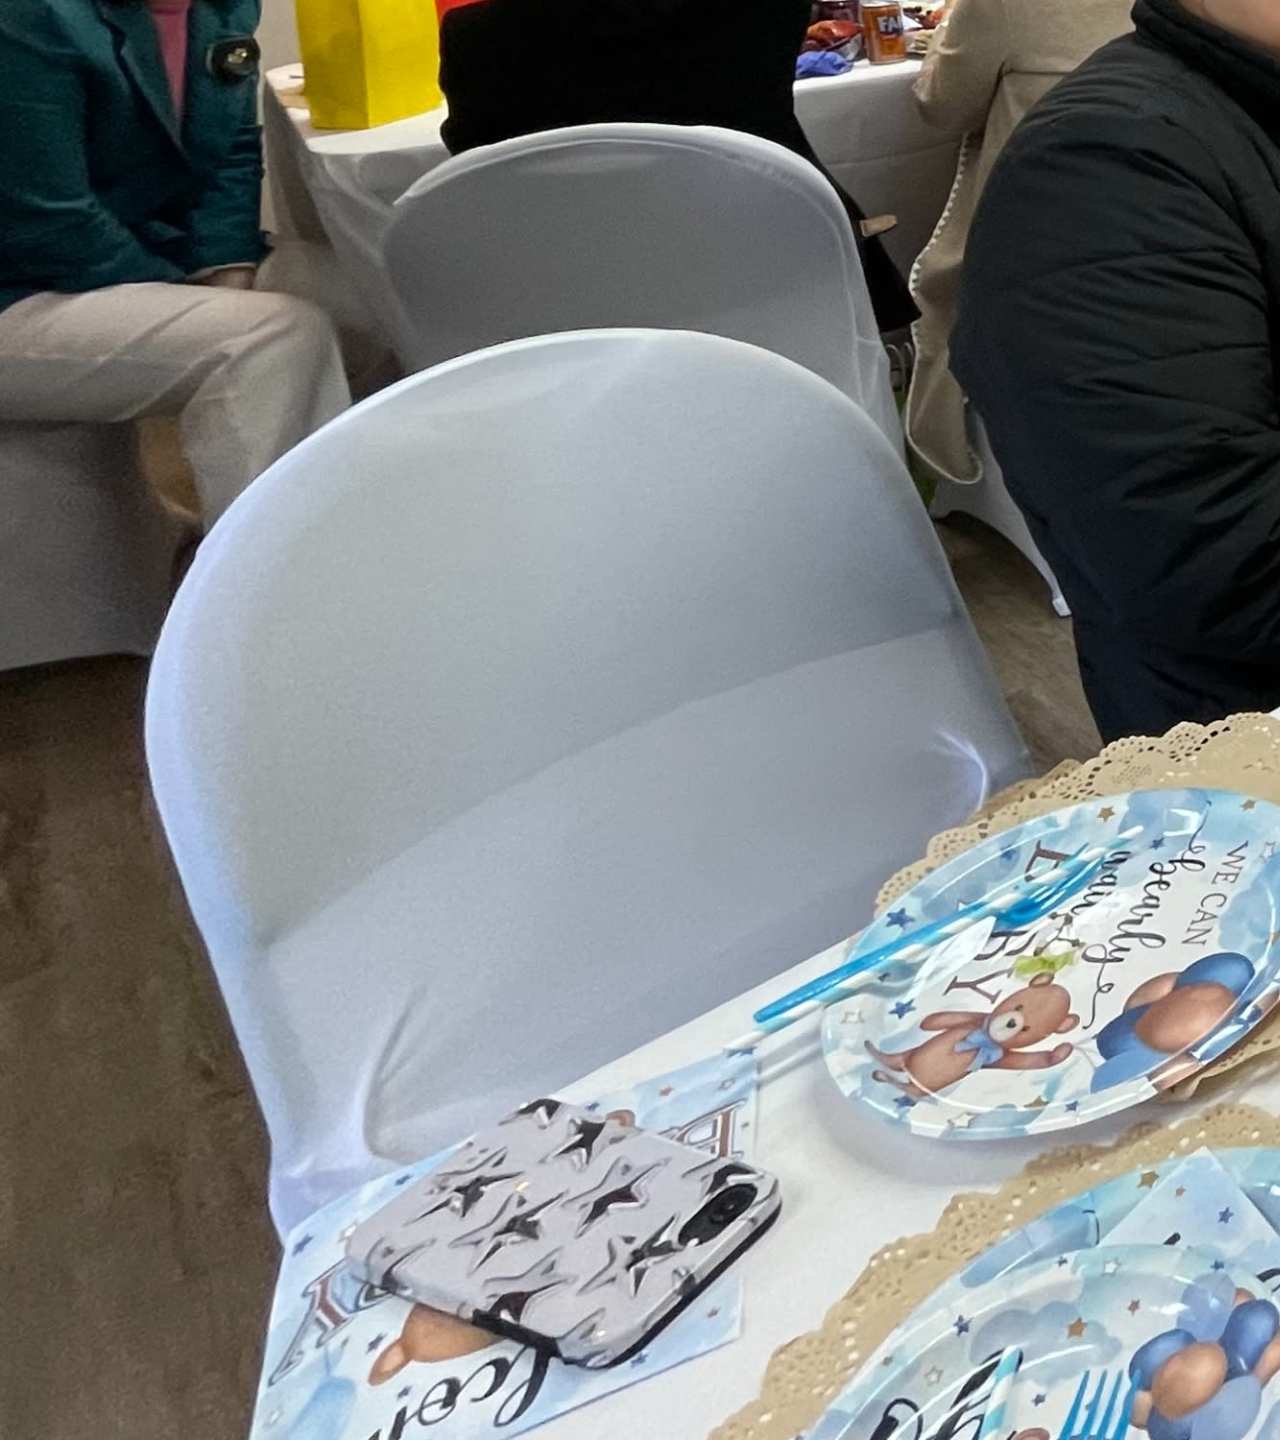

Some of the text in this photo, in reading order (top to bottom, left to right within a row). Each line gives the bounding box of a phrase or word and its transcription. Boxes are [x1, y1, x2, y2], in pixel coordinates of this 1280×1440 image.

[1081, 835, 1208, 970] bearly
[1181, 839, 1251, 948] WE CAN
